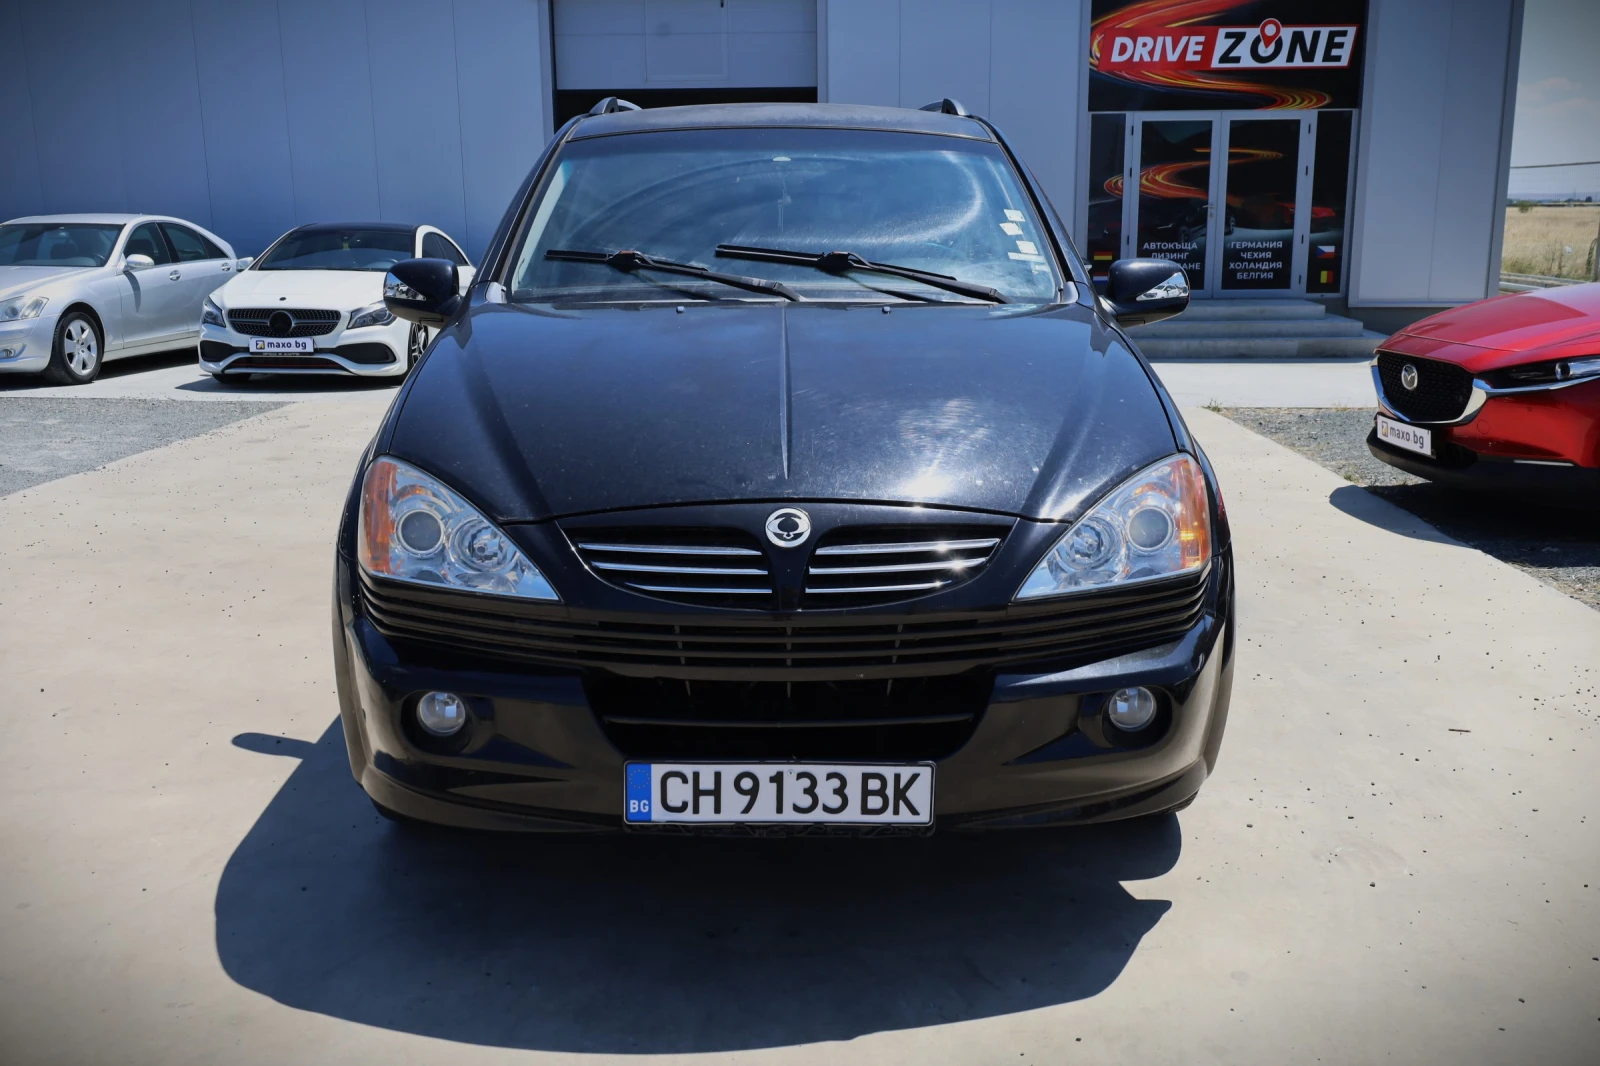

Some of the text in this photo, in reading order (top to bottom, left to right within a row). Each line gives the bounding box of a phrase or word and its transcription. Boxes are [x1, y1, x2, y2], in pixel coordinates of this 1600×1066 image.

[1110, 29, 1349, 65] DRIVE ZONE
[1142, 242, 1198, 250] АВТОКЪЩА
[1230, 240, 1283, 249] ГЕРМАНИЯ
[1151, 252, 1190, 260] ЛИЗИНГ
[1240, 251, 1272, 259] ЧЕХИЯ
[1228, 261, 1283, 270] ХОЛАНДИЯ
[1236, 271, 1274, 280] БЕЛГИЯ
[733, 770, 849, 815] 9133
[629, 800, 650, 813] BG
